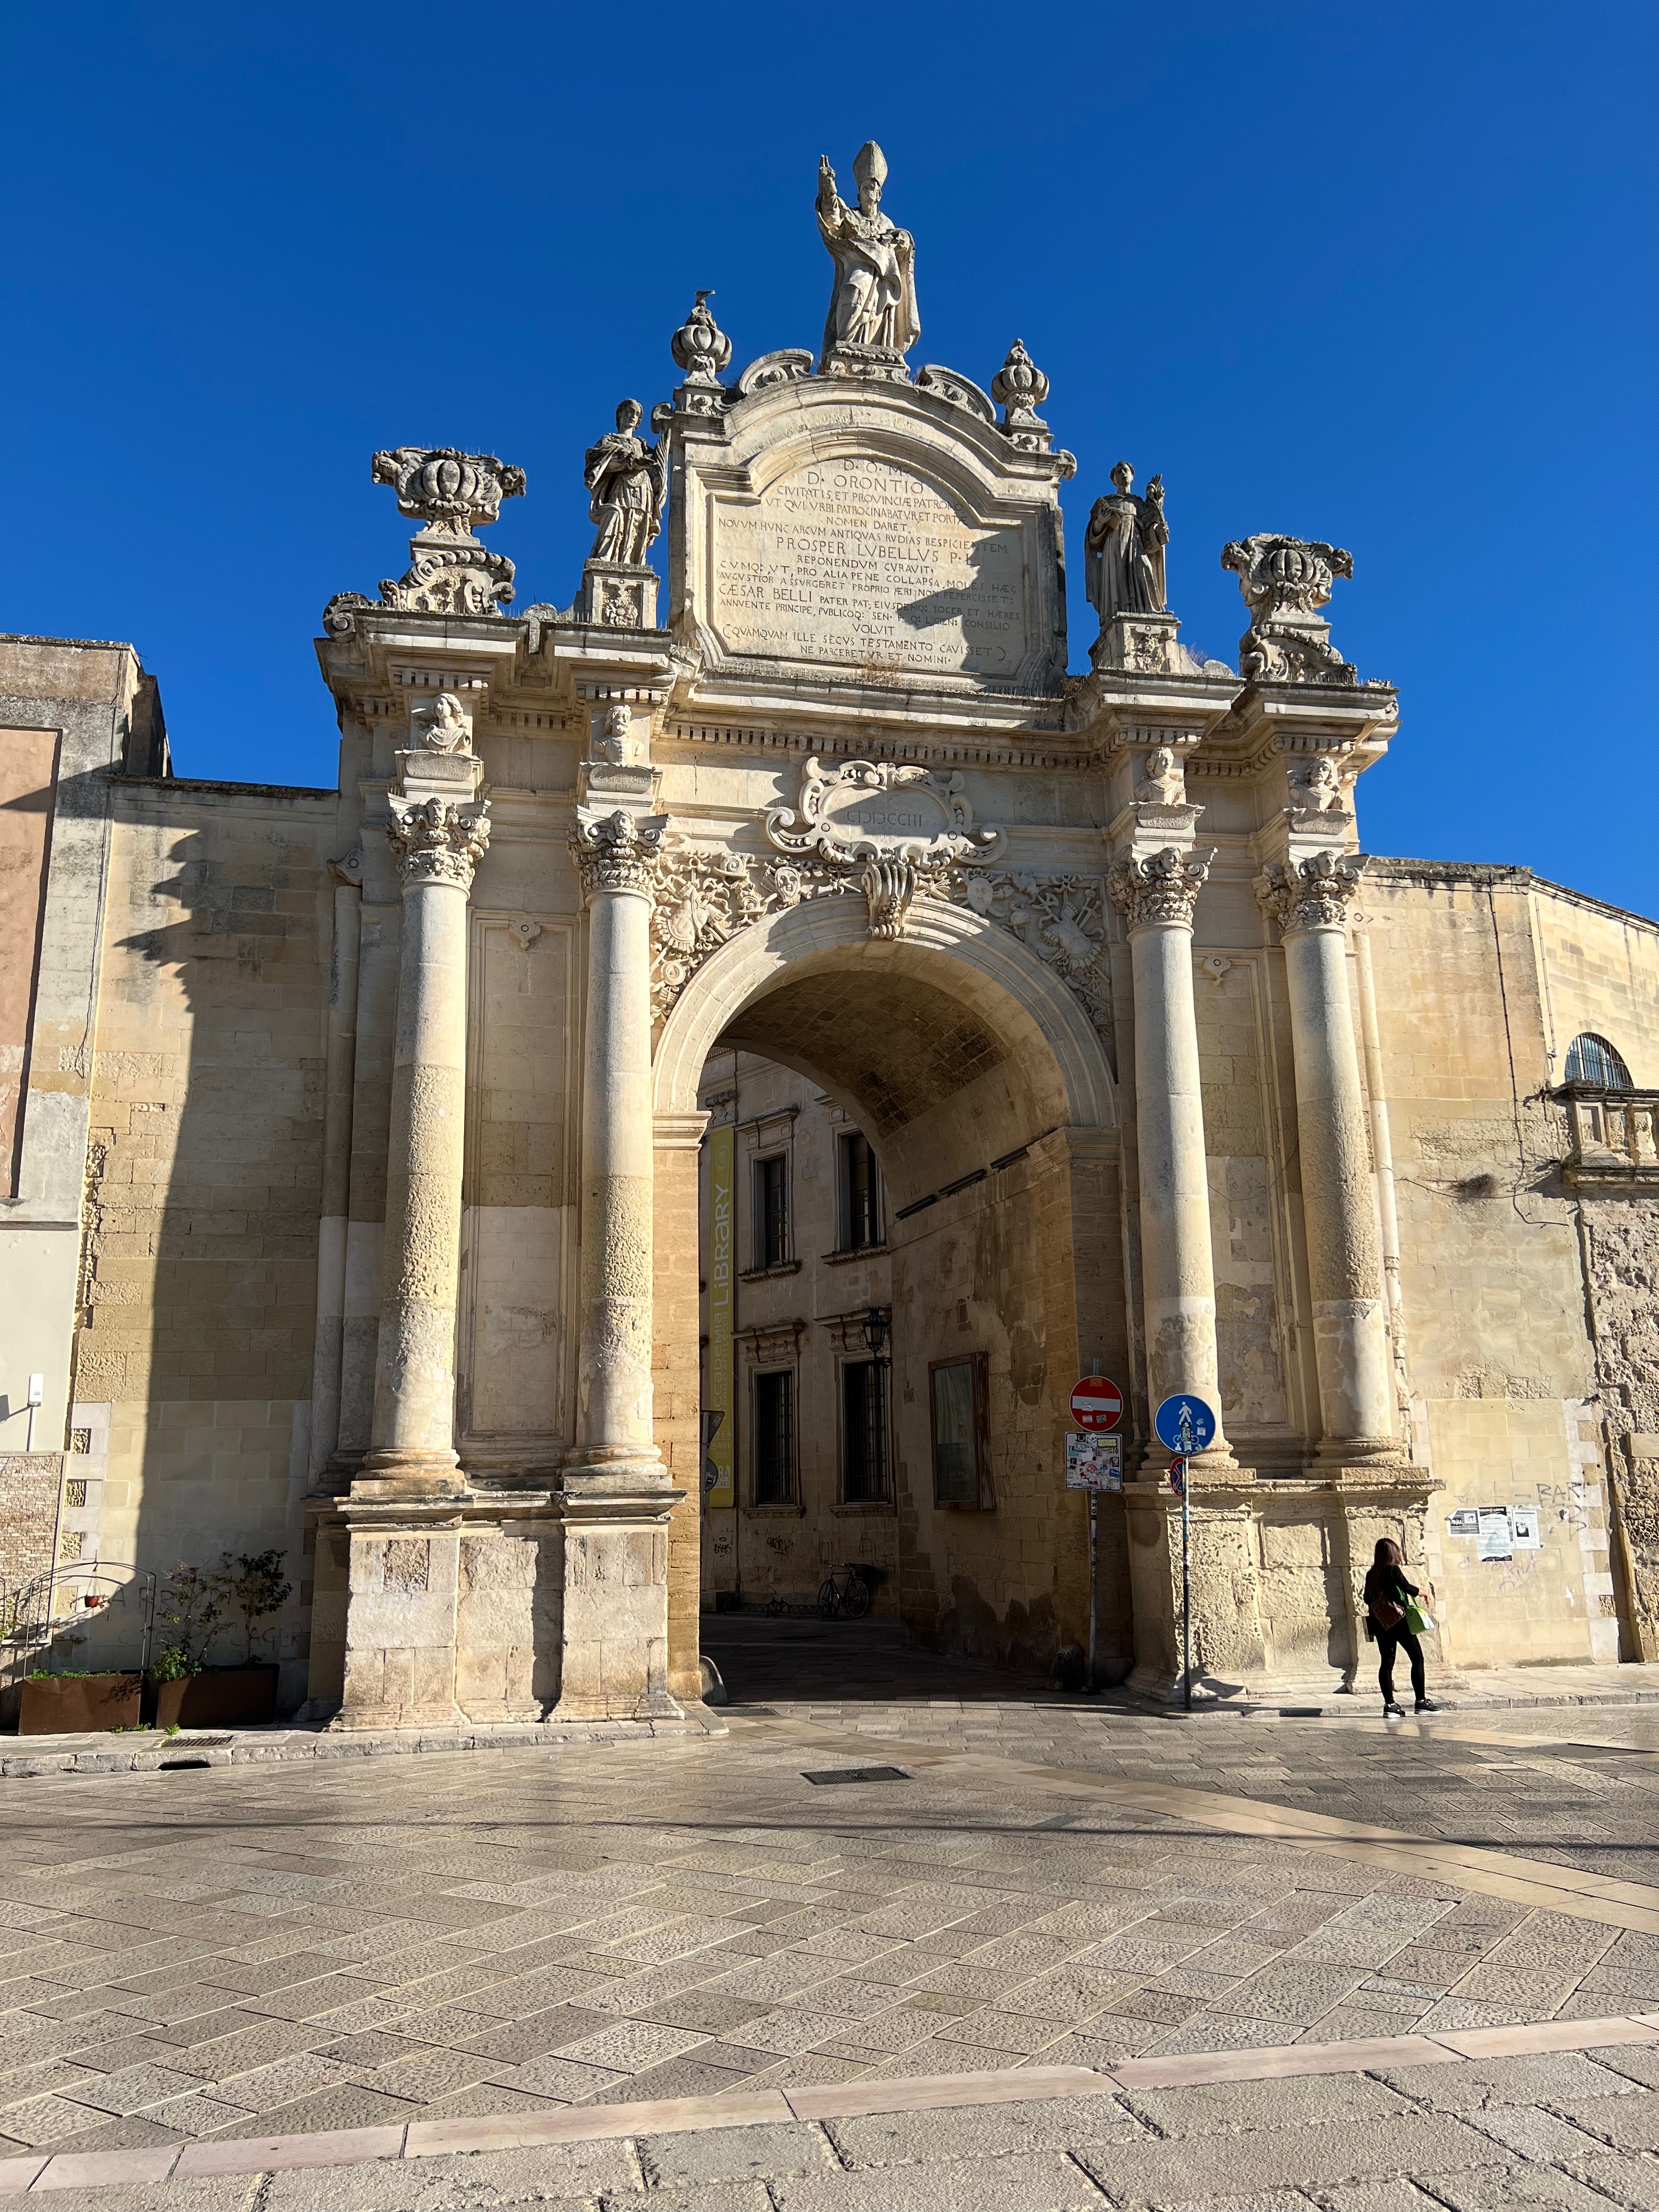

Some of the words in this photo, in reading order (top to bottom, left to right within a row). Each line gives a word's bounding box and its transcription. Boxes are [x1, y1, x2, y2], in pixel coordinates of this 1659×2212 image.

[834, 475, 923, 494] ORONTIO
[835, 491, 849, 500] ET
[766, 498, 780, 507] VT
[785, 500, 805, 512] QVI
[810, 501, 833, 512] VRBI
[919, 512, 930, 521] ET
[827, 516, 866, 527] NOMEN
[719, 518, 757, 529] NOVVM
[760, 522, 788, 533] HVNC
[792, 525, 826, 536] ARCVM
[830, 529, 881, 542] ANTIQVAS
[885, 534, 921, 545] RVDIAS
[926, 538, 1008, 553] RESPICIENTEM
[777, 537, 845, 555] PROSPER
[858, 544, 939, 562] LVBELLVS
[797, 555, 877, 569] REPONENDVM
[719, 572, 774, 583] AVGVSTIOR
[853, 583, 889, 593] PROPRIO
[918, 589, 939, 598] NON
[797, 567, 816, 576] PRO
[823, 571, 848, 579] ALIA
[851, 572, 879, 581] PENE
[947, 580, 984, 590] MOLES
[773, 588, 812, 602] BELLI
[820, 596, 848, 606] PATER
[720, 599, 770, 610] ANNVENTE
[964, 619, 1010, 630] CONSILIO
[852, 623, 894, 635] VOLVIT
[793, 631, 816, 642] ILLE
[823, 635, 854, 645] SECVS
[860, 638, 933, 651] TESTAMENTO
[801, 645, 813, 653] NE
[819, 647, 883, 659] PARCERETVR
[888, 652, 902, 661] ET
